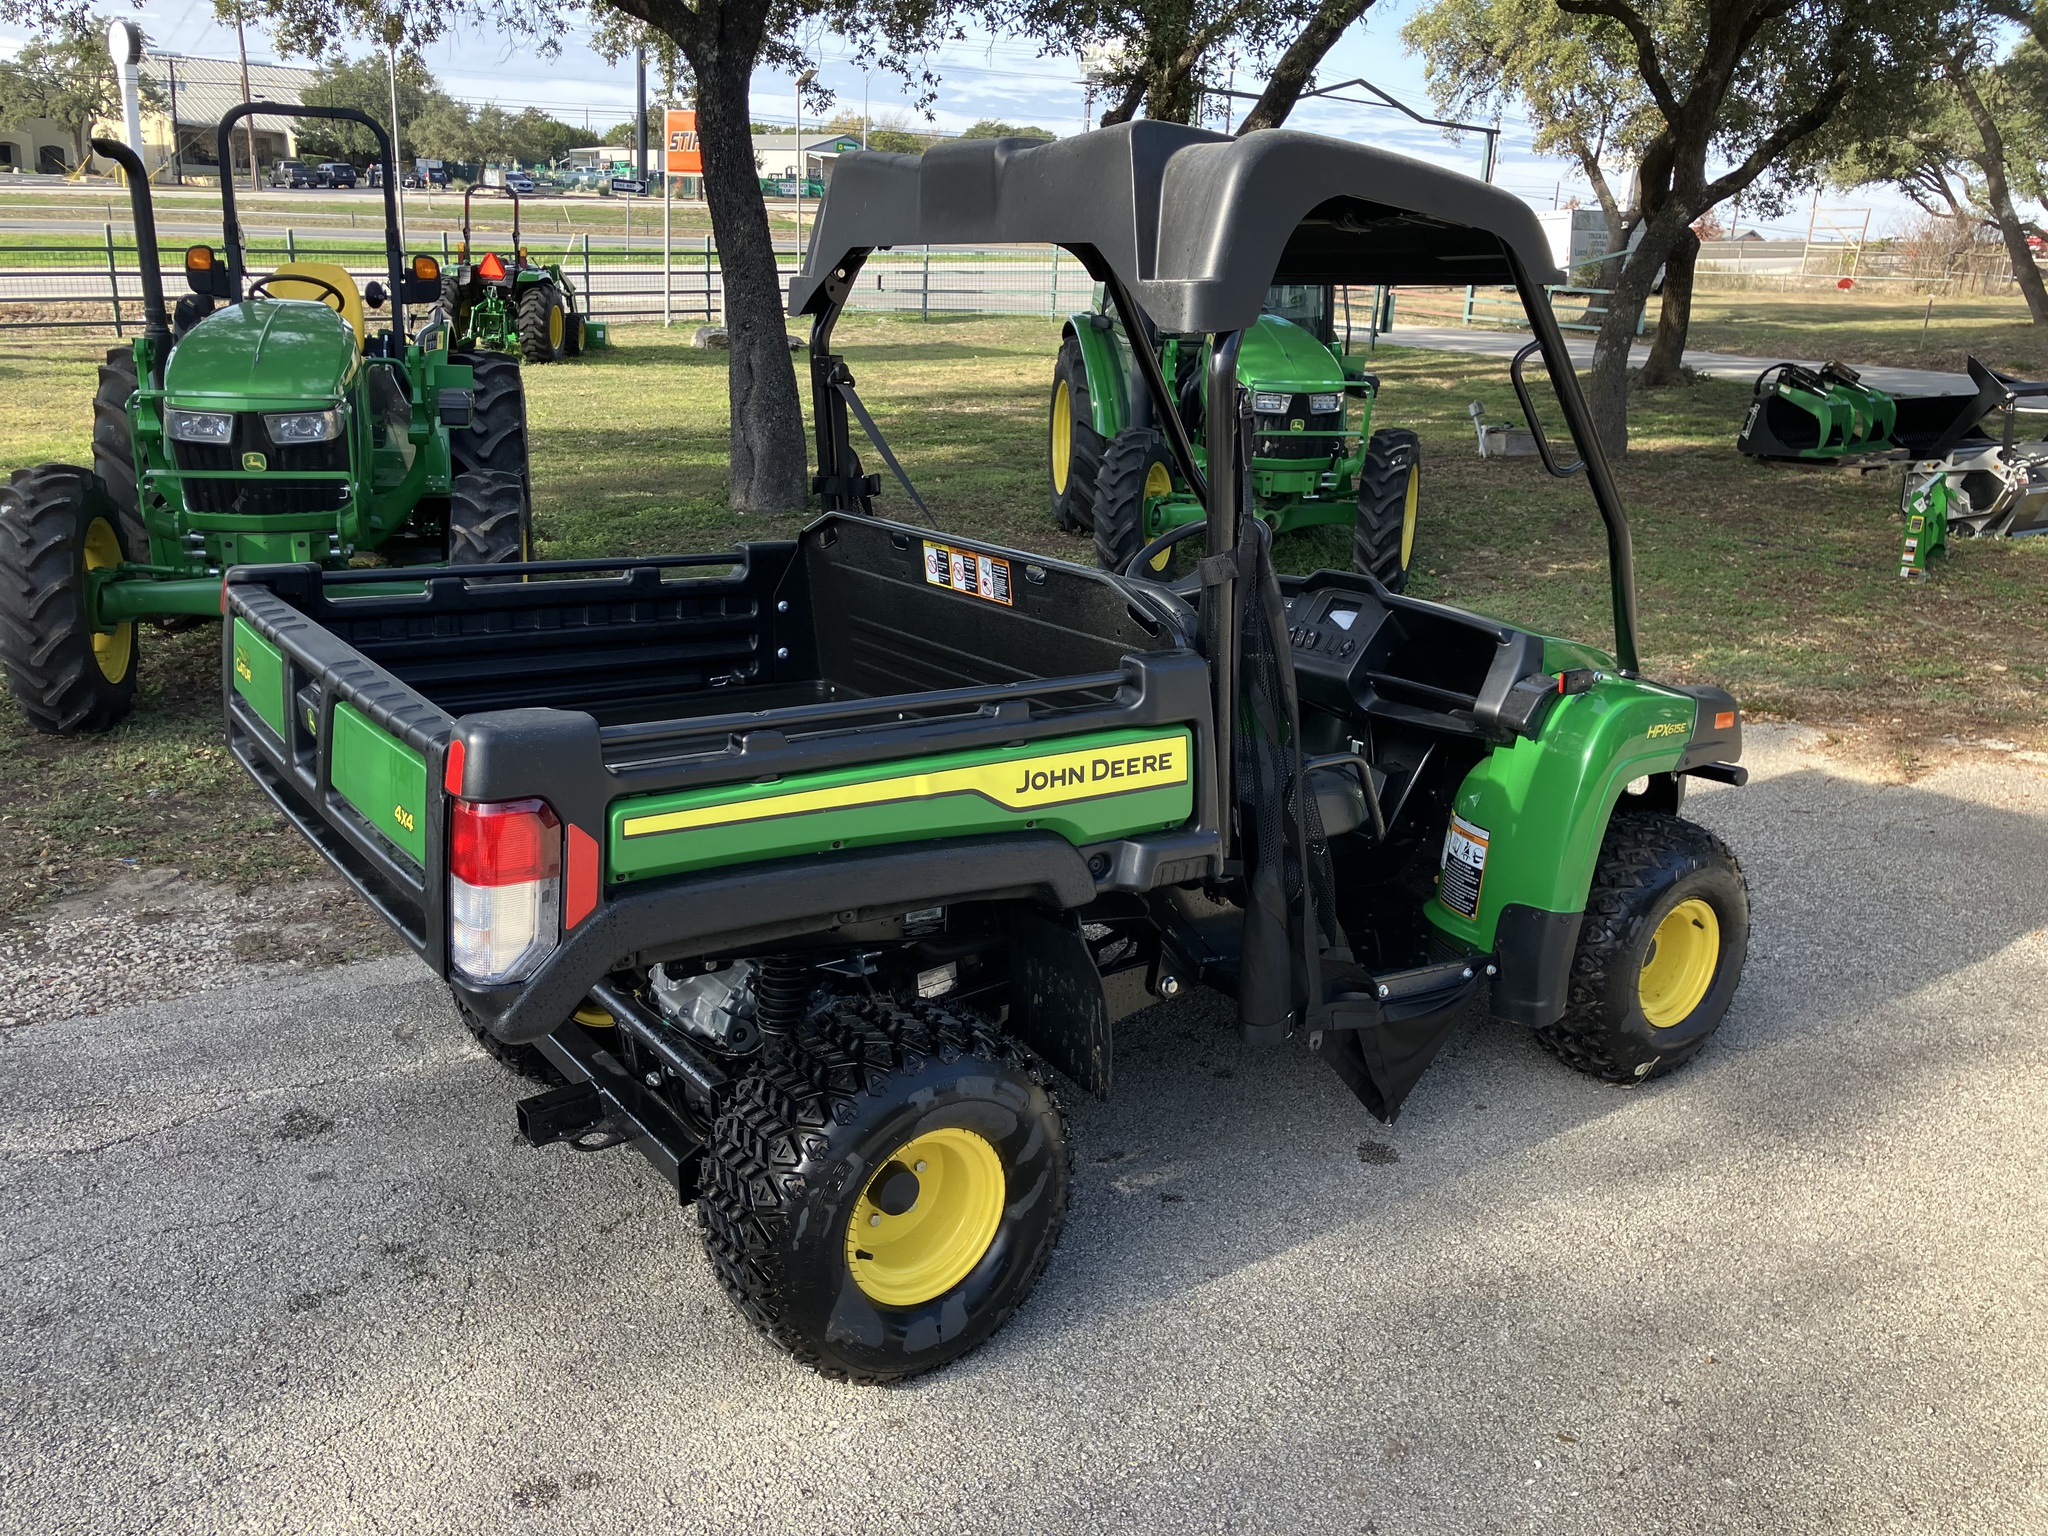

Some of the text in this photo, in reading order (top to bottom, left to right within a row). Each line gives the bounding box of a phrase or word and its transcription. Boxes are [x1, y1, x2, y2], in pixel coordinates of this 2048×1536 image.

[668, 131, 700, 152] STIH
[1646, 723, 1687, 739] HPX615E
[1016, 752, 1173, 794] JOHN DEERE
